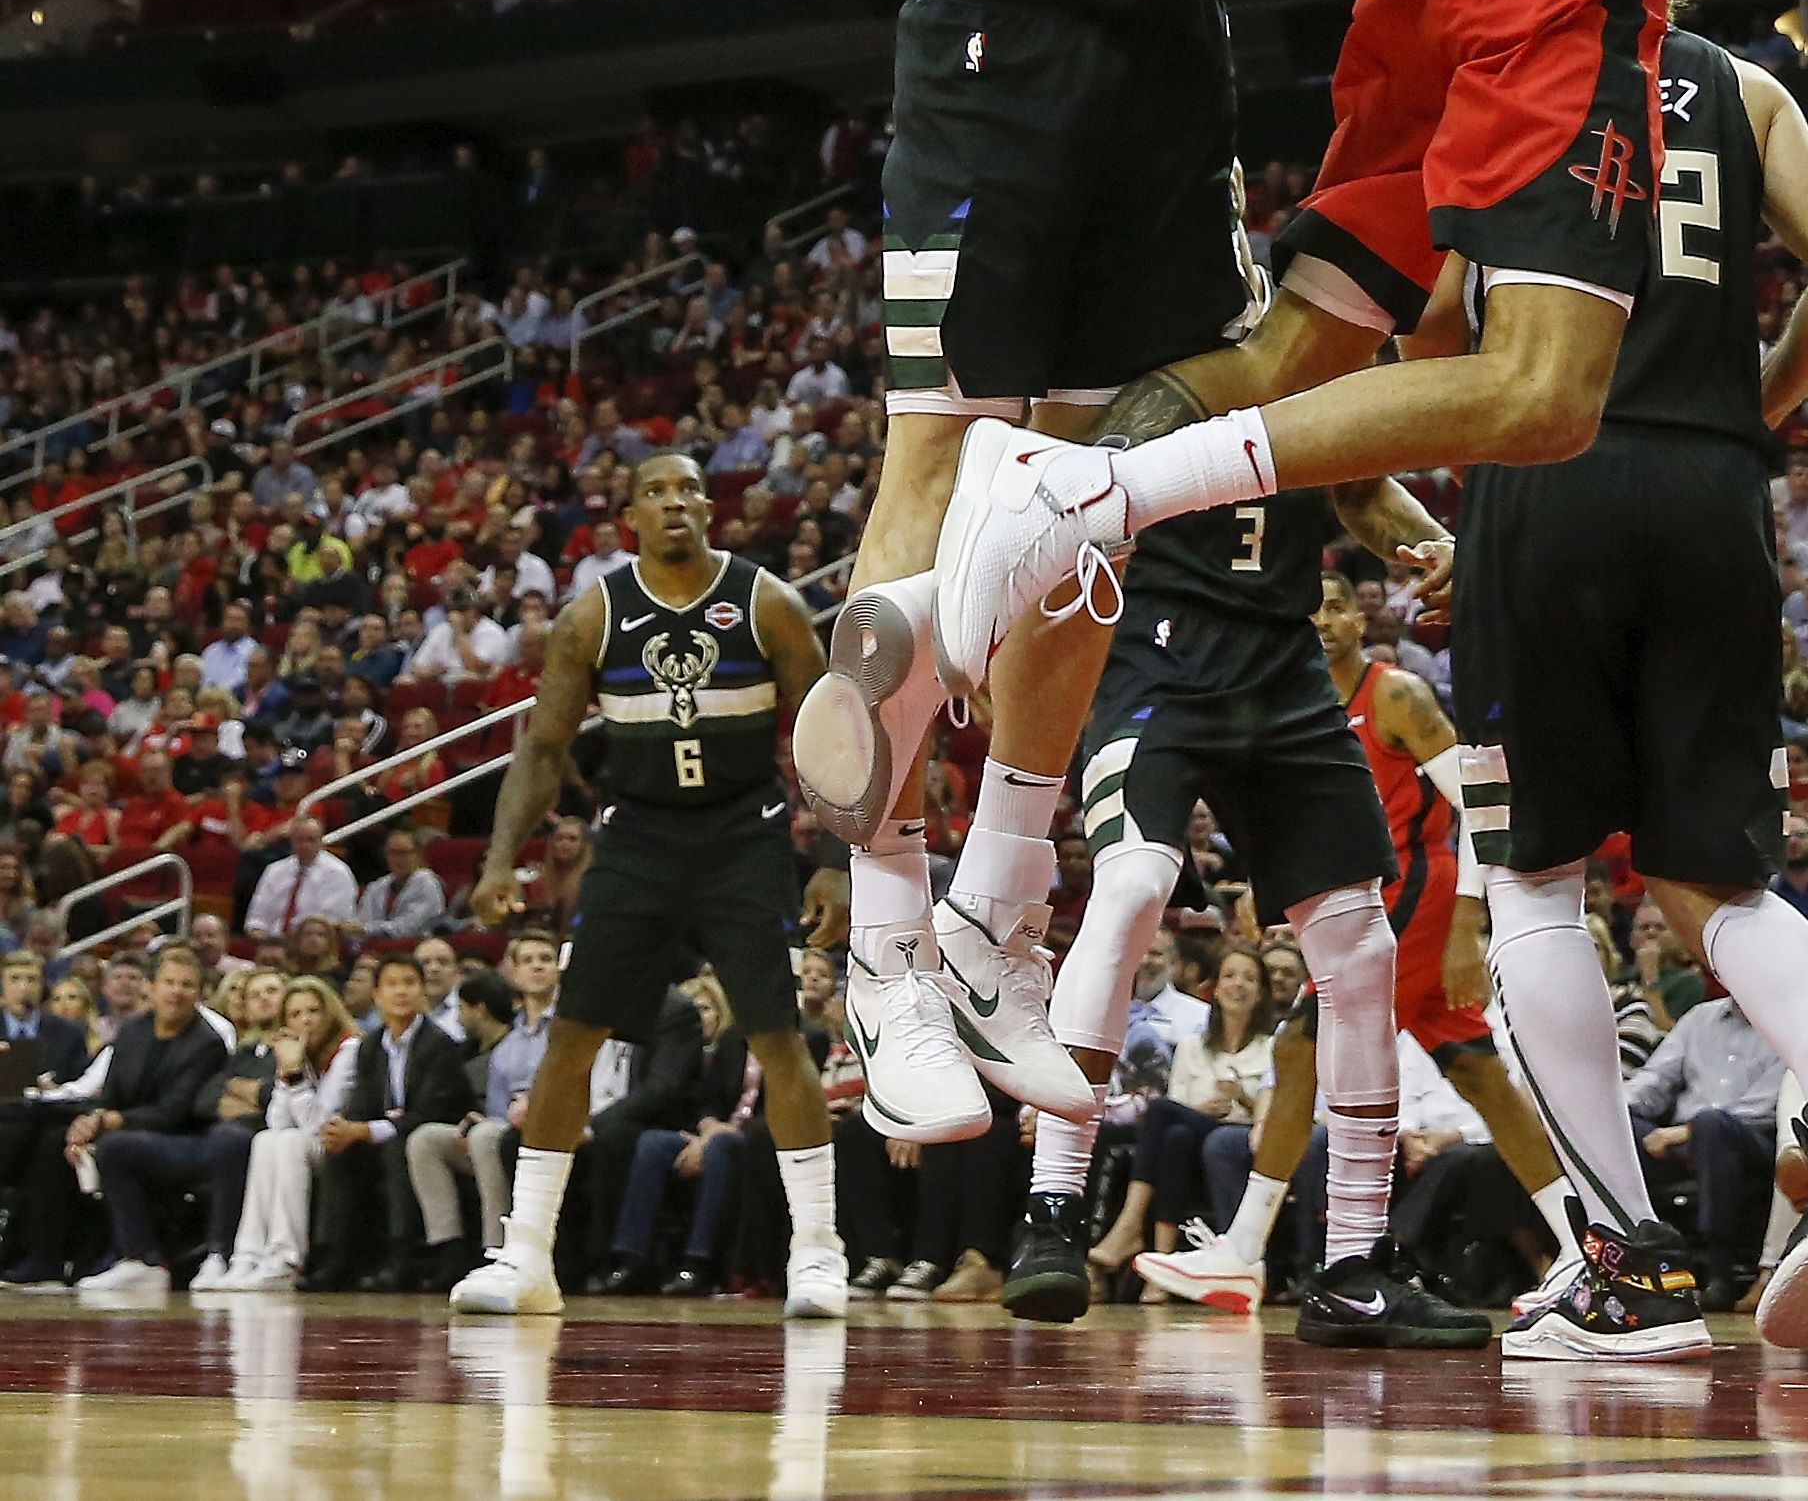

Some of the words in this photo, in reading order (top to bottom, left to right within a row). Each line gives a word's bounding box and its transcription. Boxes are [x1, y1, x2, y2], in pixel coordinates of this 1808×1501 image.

[1658, 77, 1699, 122] EZ
[1658, 148, 1721, 286] 2
[1230, 505, 1267, 573] 3
[673, 738, 706, 788] 6
